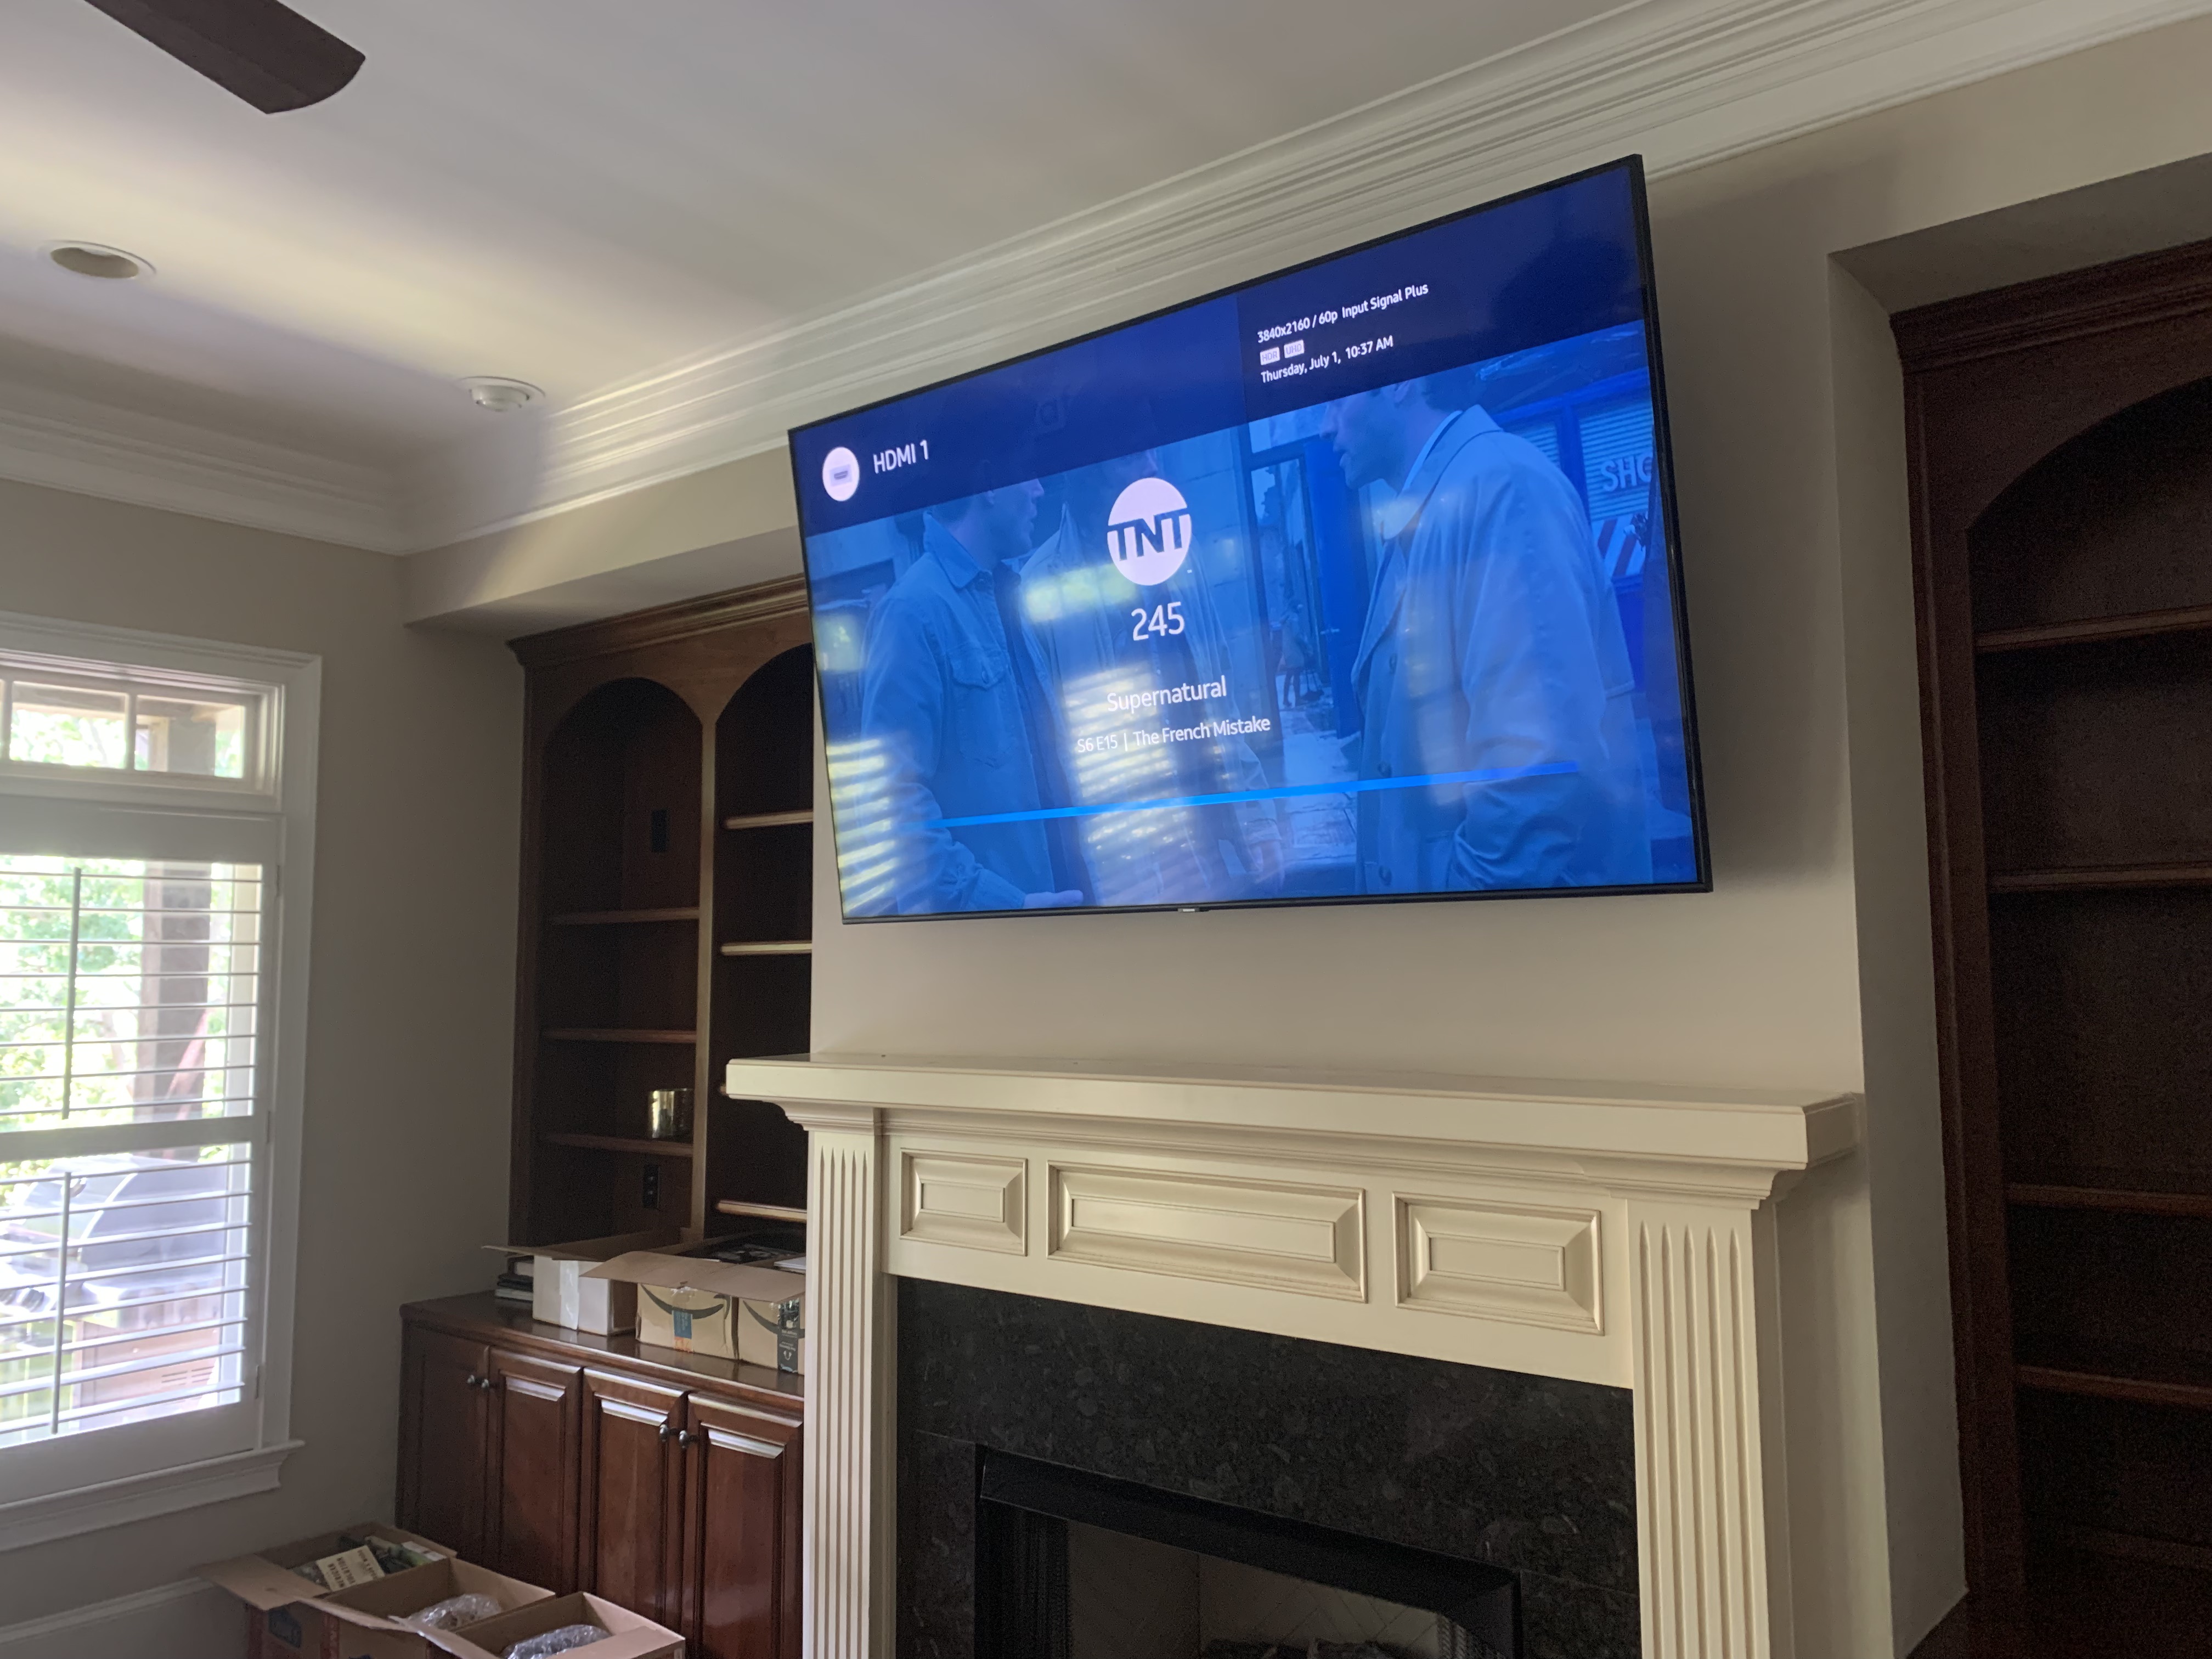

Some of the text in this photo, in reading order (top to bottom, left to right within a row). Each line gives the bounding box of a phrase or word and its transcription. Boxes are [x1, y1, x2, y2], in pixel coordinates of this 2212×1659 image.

[1257, 317, 1311, 343] 3840x2160
[1318, 311, 1338, 324] 60p
[1342, 300, 1369, 319] Input
[1370, 289, 1403, 311] Signal
[1404, 284, 1429, 300] Plus
[1261, 335, 1393, 383] Thursday, July 1, 10:37 AM
[1285, 343, 1302, 354] UHD
[873, 439, 929, 474] HDMI 1
[1107, 507, 1190, 562] TNT
[1131, 601, 1185, 641] 245
[1107, 675, 1227, 714] Supernatural
[1077, 737, 1094, 753] S6
[1097, 733, 1118, 751] E15
[1133, 729, 1159, 747] The
[1162, 721, 1209, 743] French
[1213, 715, 1271, 737] Mistake
